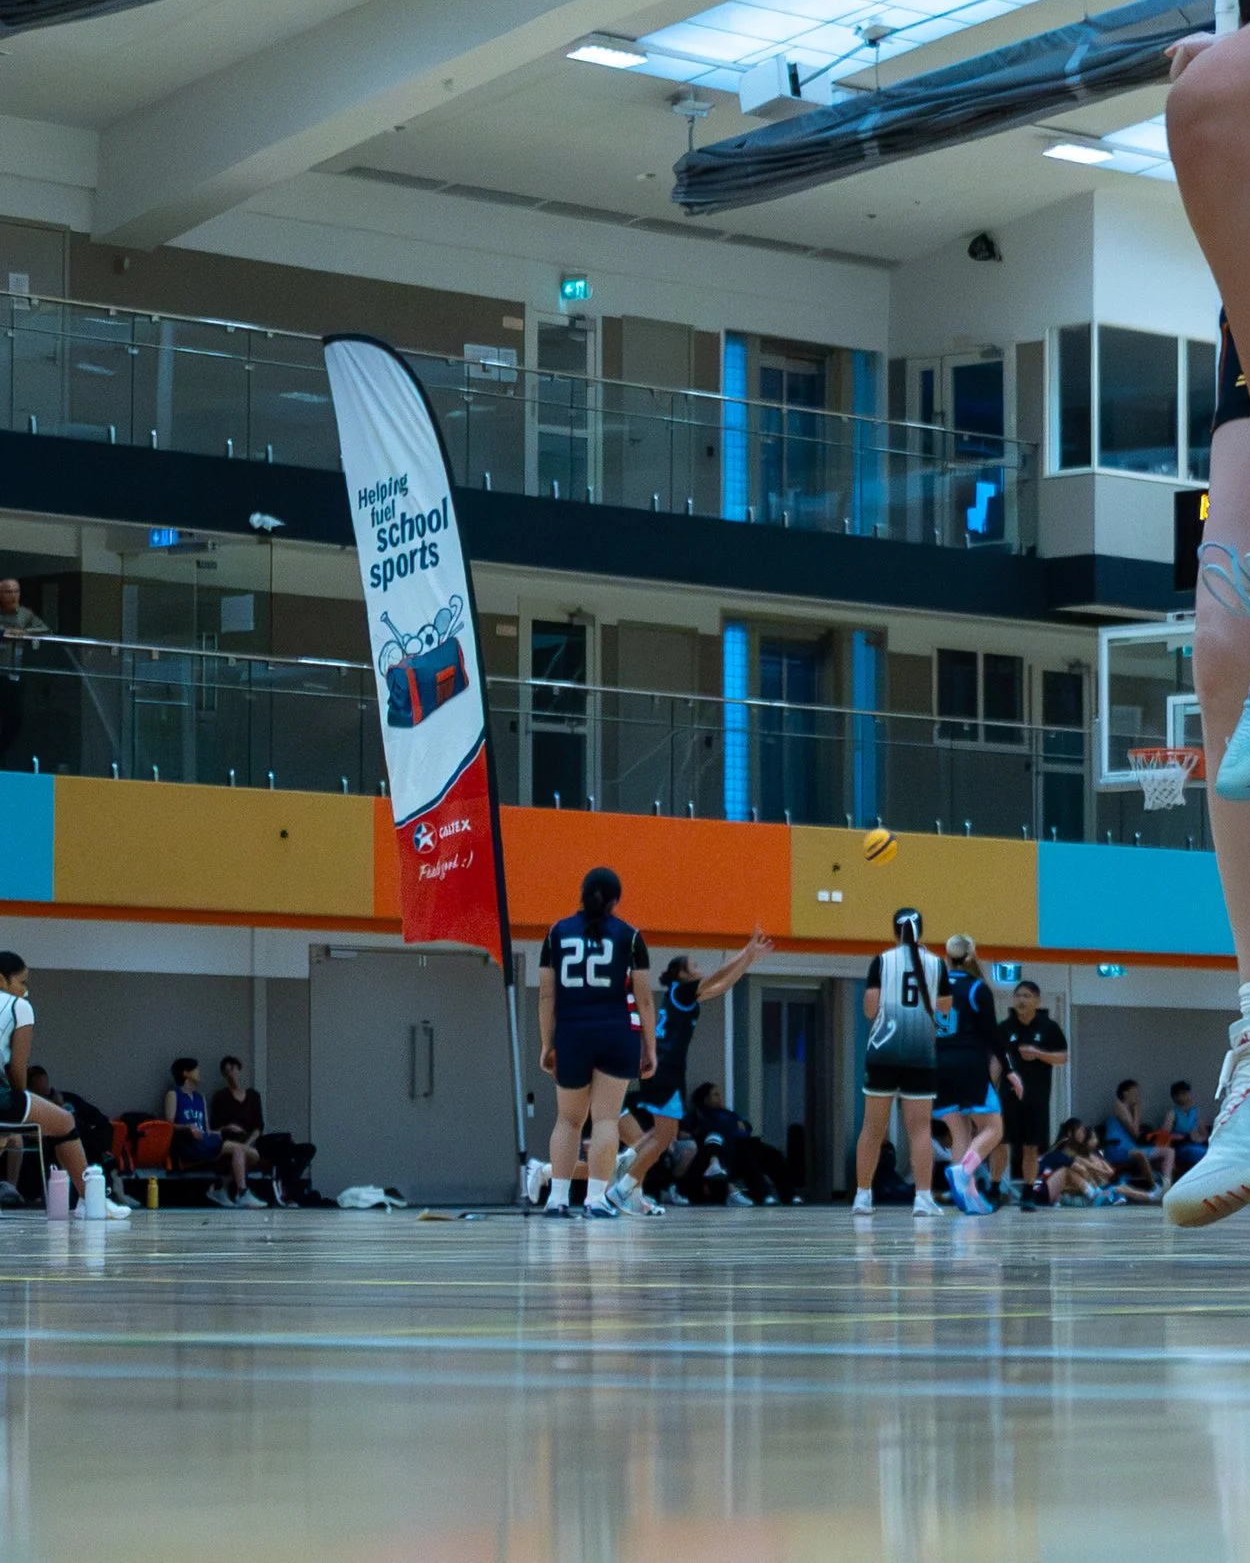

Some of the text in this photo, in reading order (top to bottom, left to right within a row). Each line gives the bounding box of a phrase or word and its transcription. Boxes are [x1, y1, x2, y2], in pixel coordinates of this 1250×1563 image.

[358, 473, 408, 510] Helping
[371, 500, 395, 528] fuel
[376, 495, 448, 553] school
[370, 540, 439, 592] sports
[560, 939, 614, 988] 22
[902, 971, 920, 1008] 6
